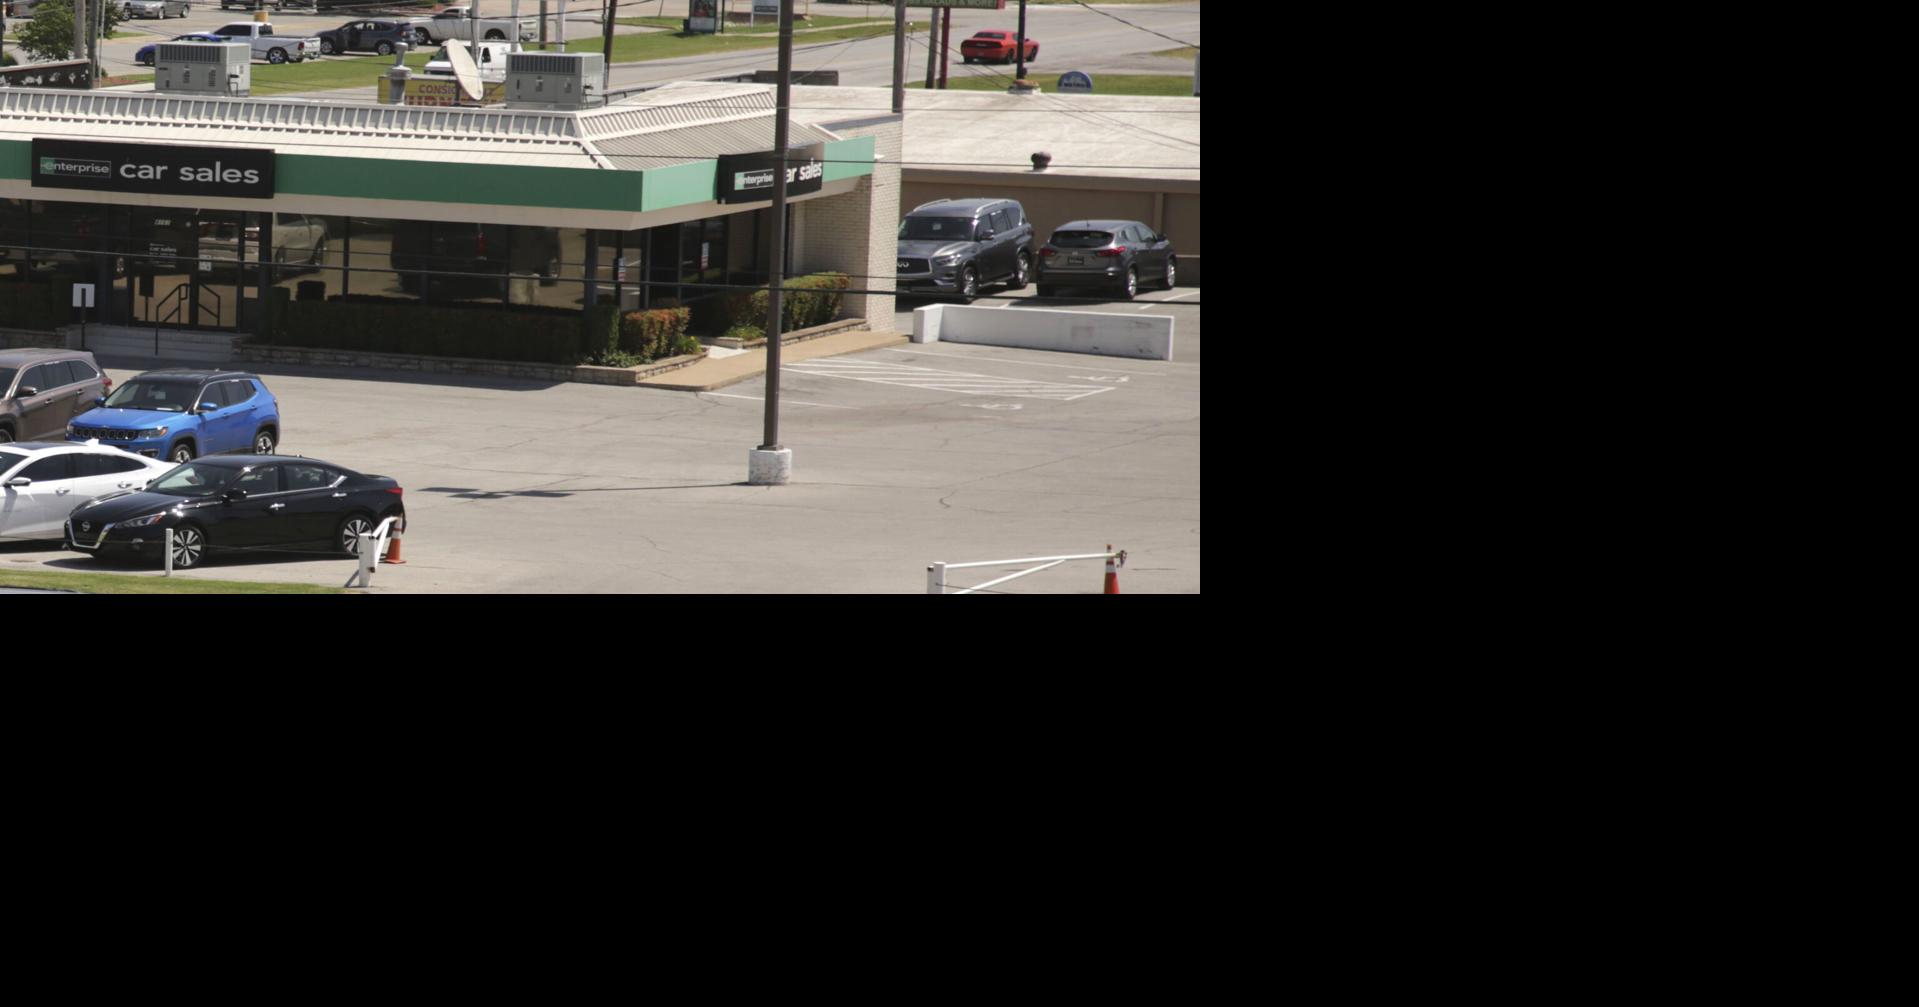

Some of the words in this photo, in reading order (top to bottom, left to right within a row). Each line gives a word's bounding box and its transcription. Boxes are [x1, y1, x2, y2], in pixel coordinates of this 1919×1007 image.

[41, 159, 110, 176] enterprise
[120, 163, 168, 179] car
[179, 161, 259, 184] sales
[785, 166, 798, 183] ar
[798, 157, 823, 181] sales
